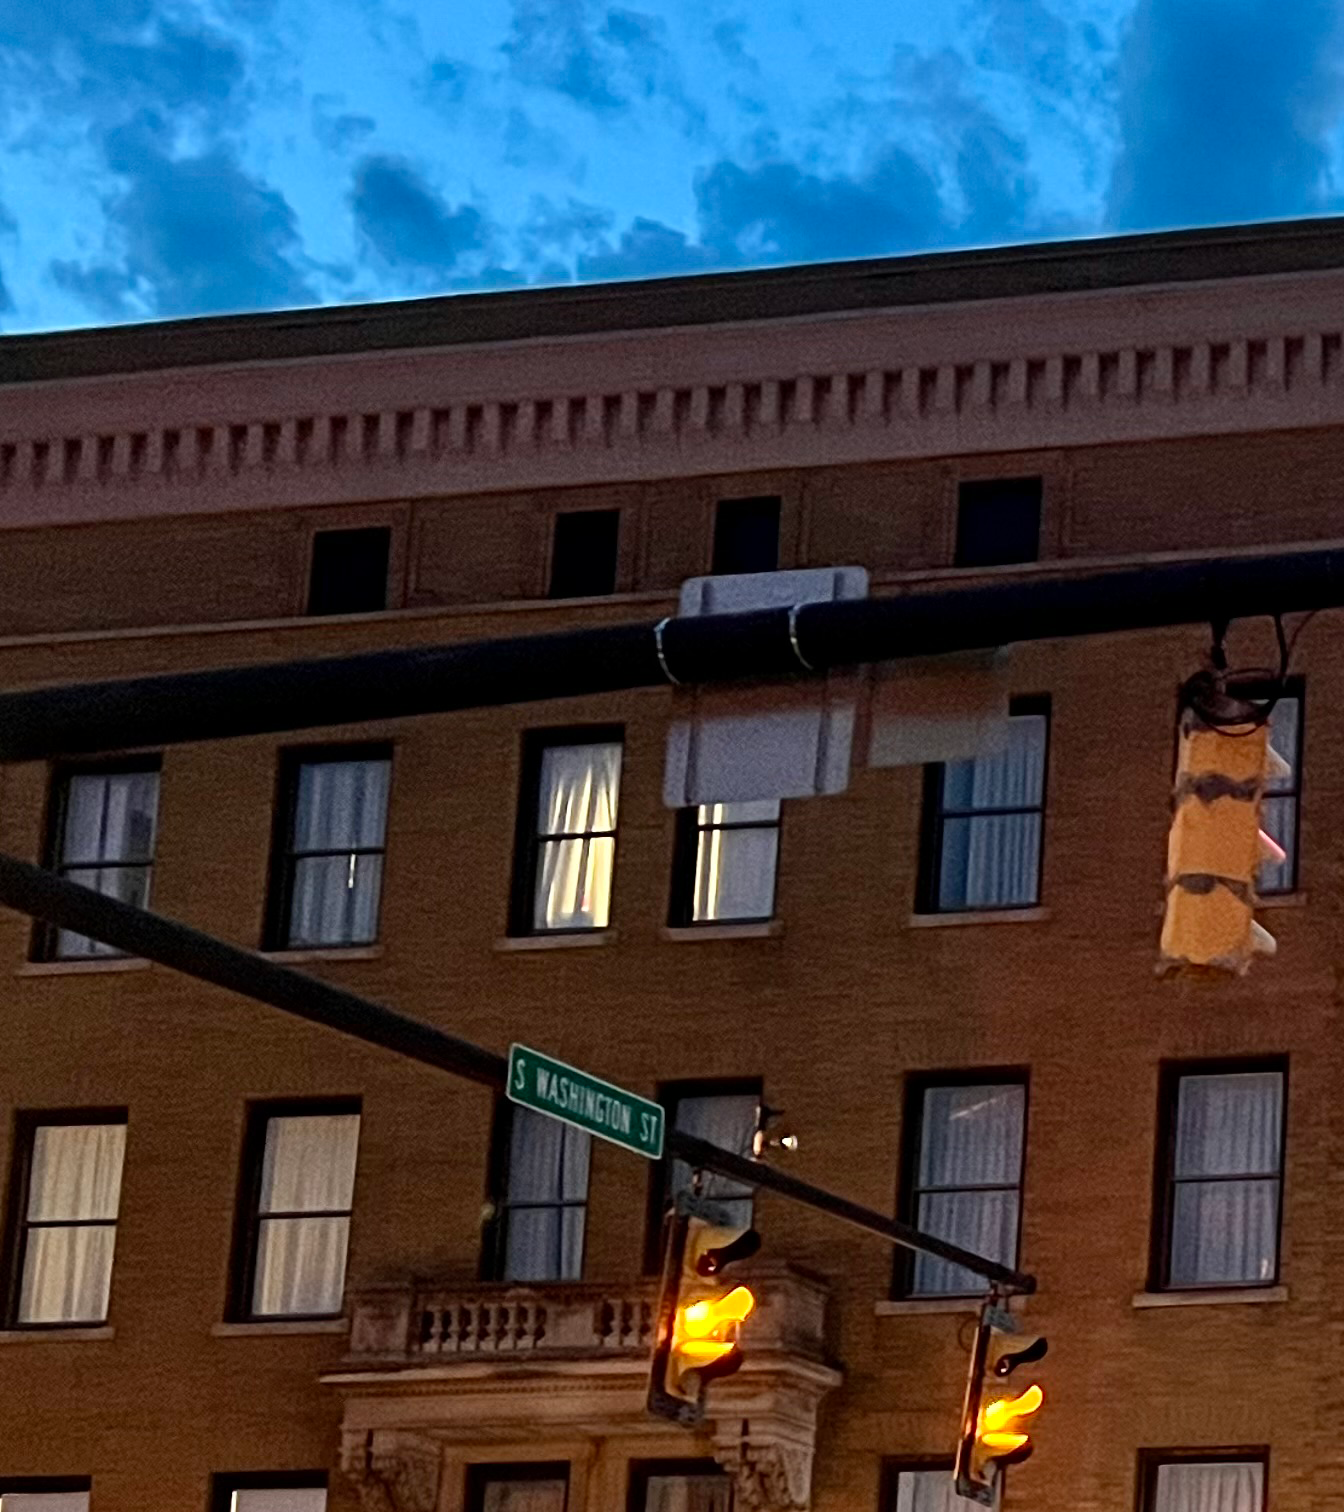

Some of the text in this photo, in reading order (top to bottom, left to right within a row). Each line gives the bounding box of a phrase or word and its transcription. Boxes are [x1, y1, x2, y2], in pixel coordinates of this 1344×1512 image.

[514, 1058, 658, 1145] S WASHINGTON ST
